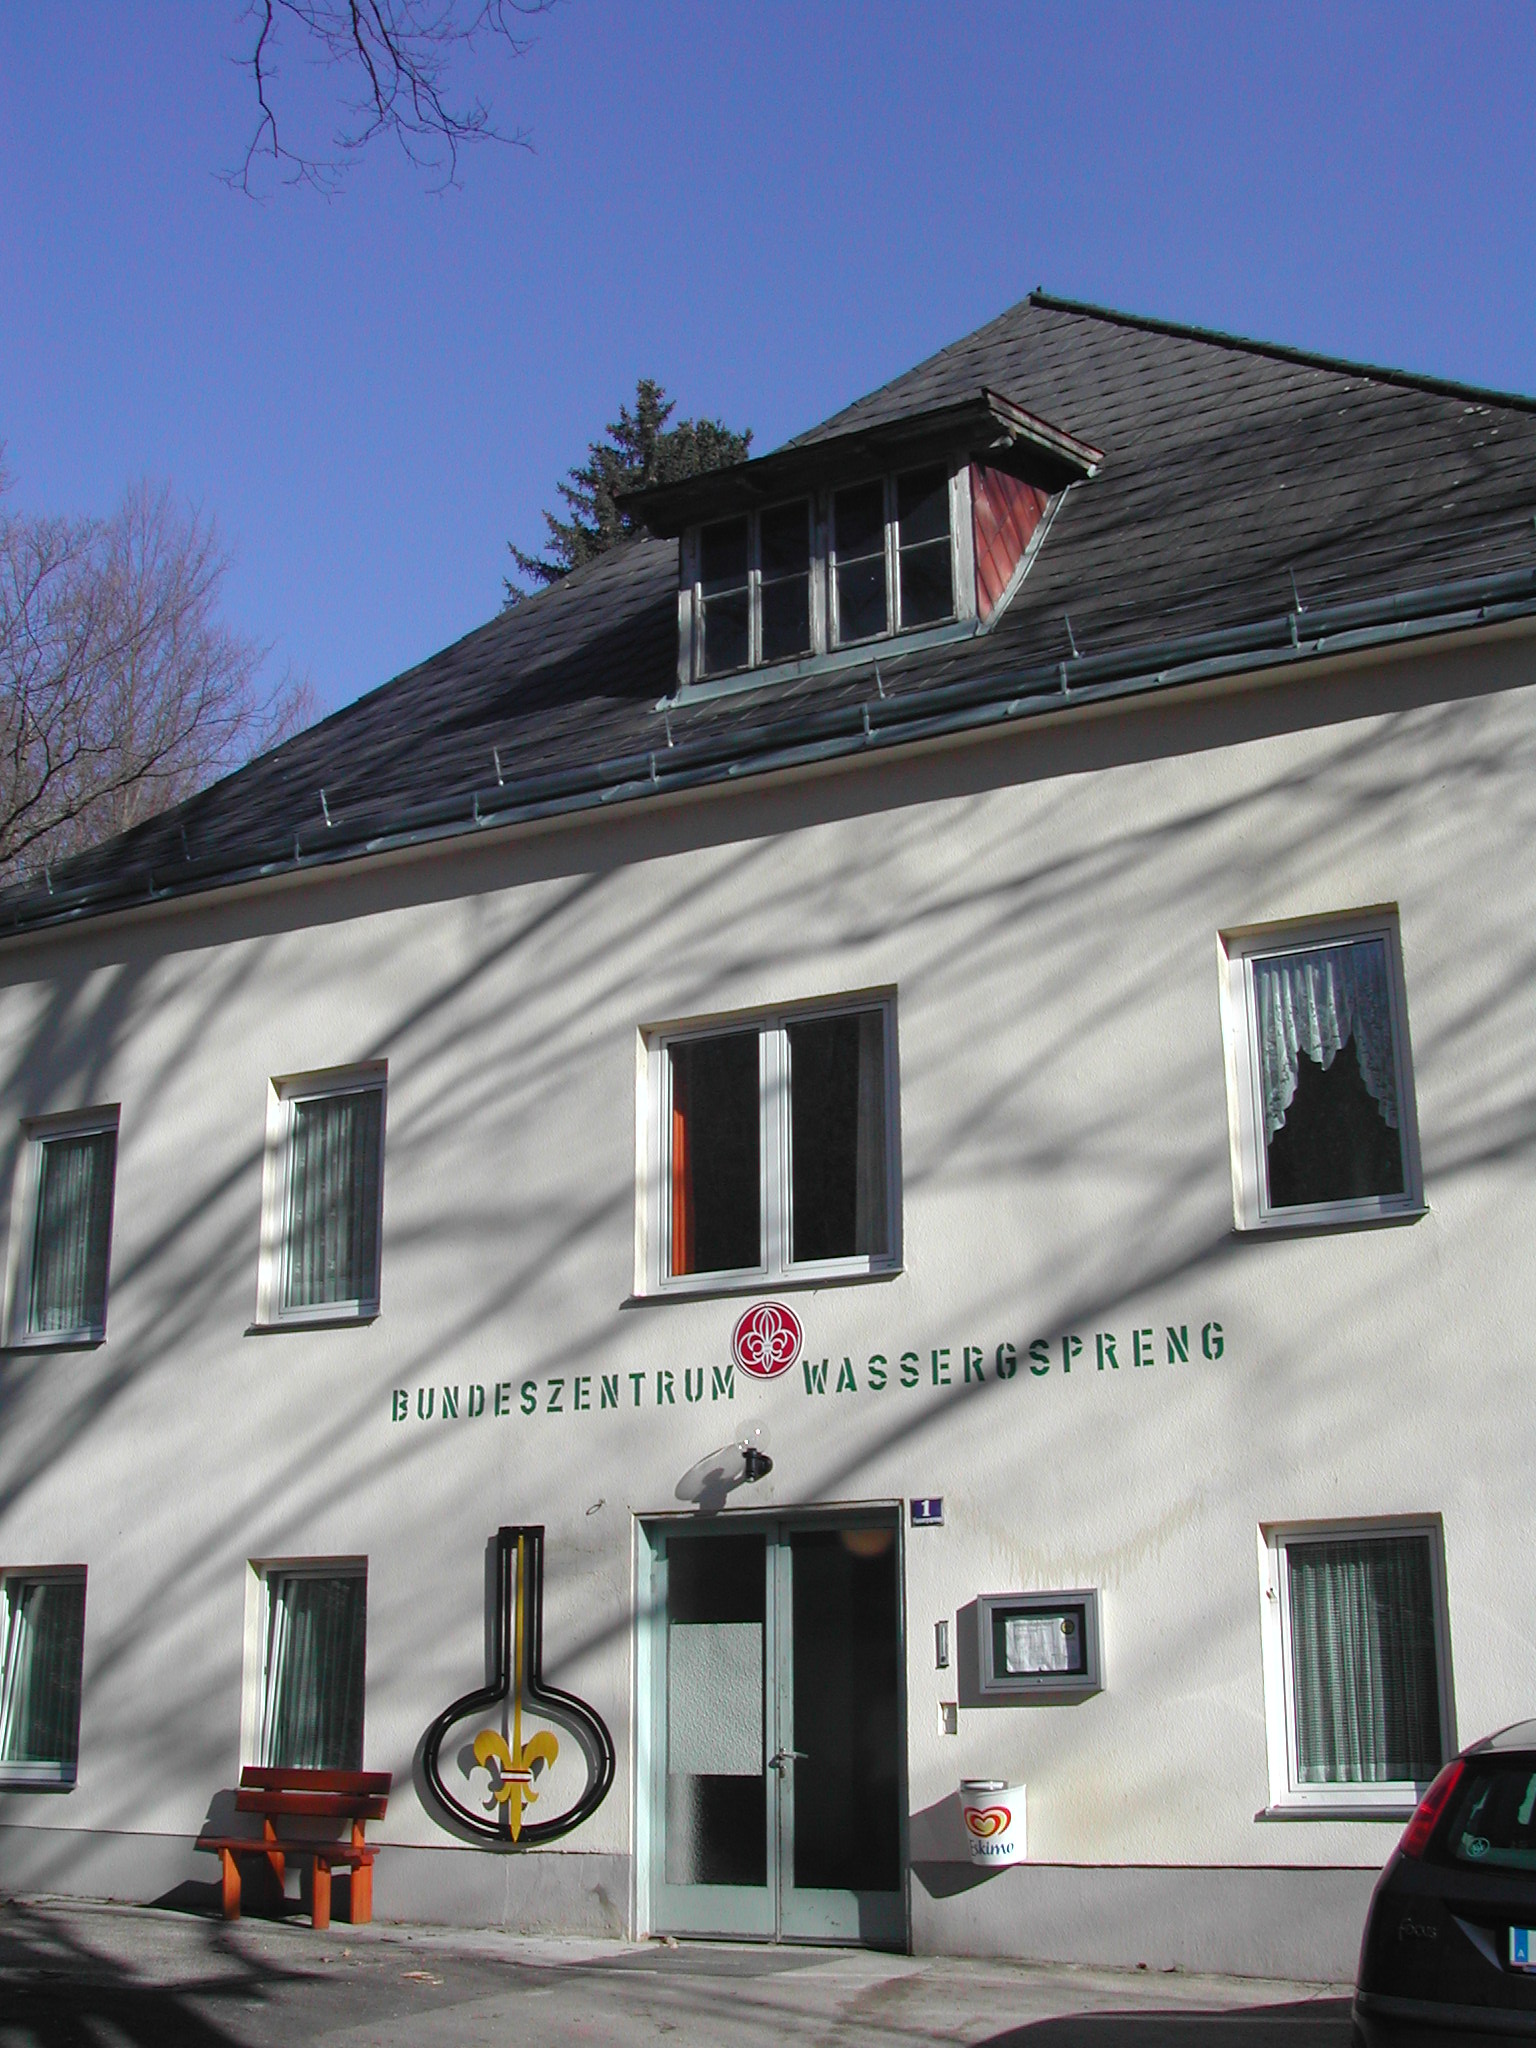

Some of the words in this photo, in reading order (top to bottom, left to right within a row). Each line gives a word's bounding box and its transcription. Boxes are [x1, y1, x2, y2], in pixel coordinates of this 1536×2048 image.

[391, 1364, 735, 1422] BUNDESZENTRUM
[802, 1321, 1225, 1395] WASSERGSPRENG
[921, 1499, 931, 1517] 1
[969, 1839, 1015, 1857] Eskimo
[1517, 1949, 1525, 1957] A
